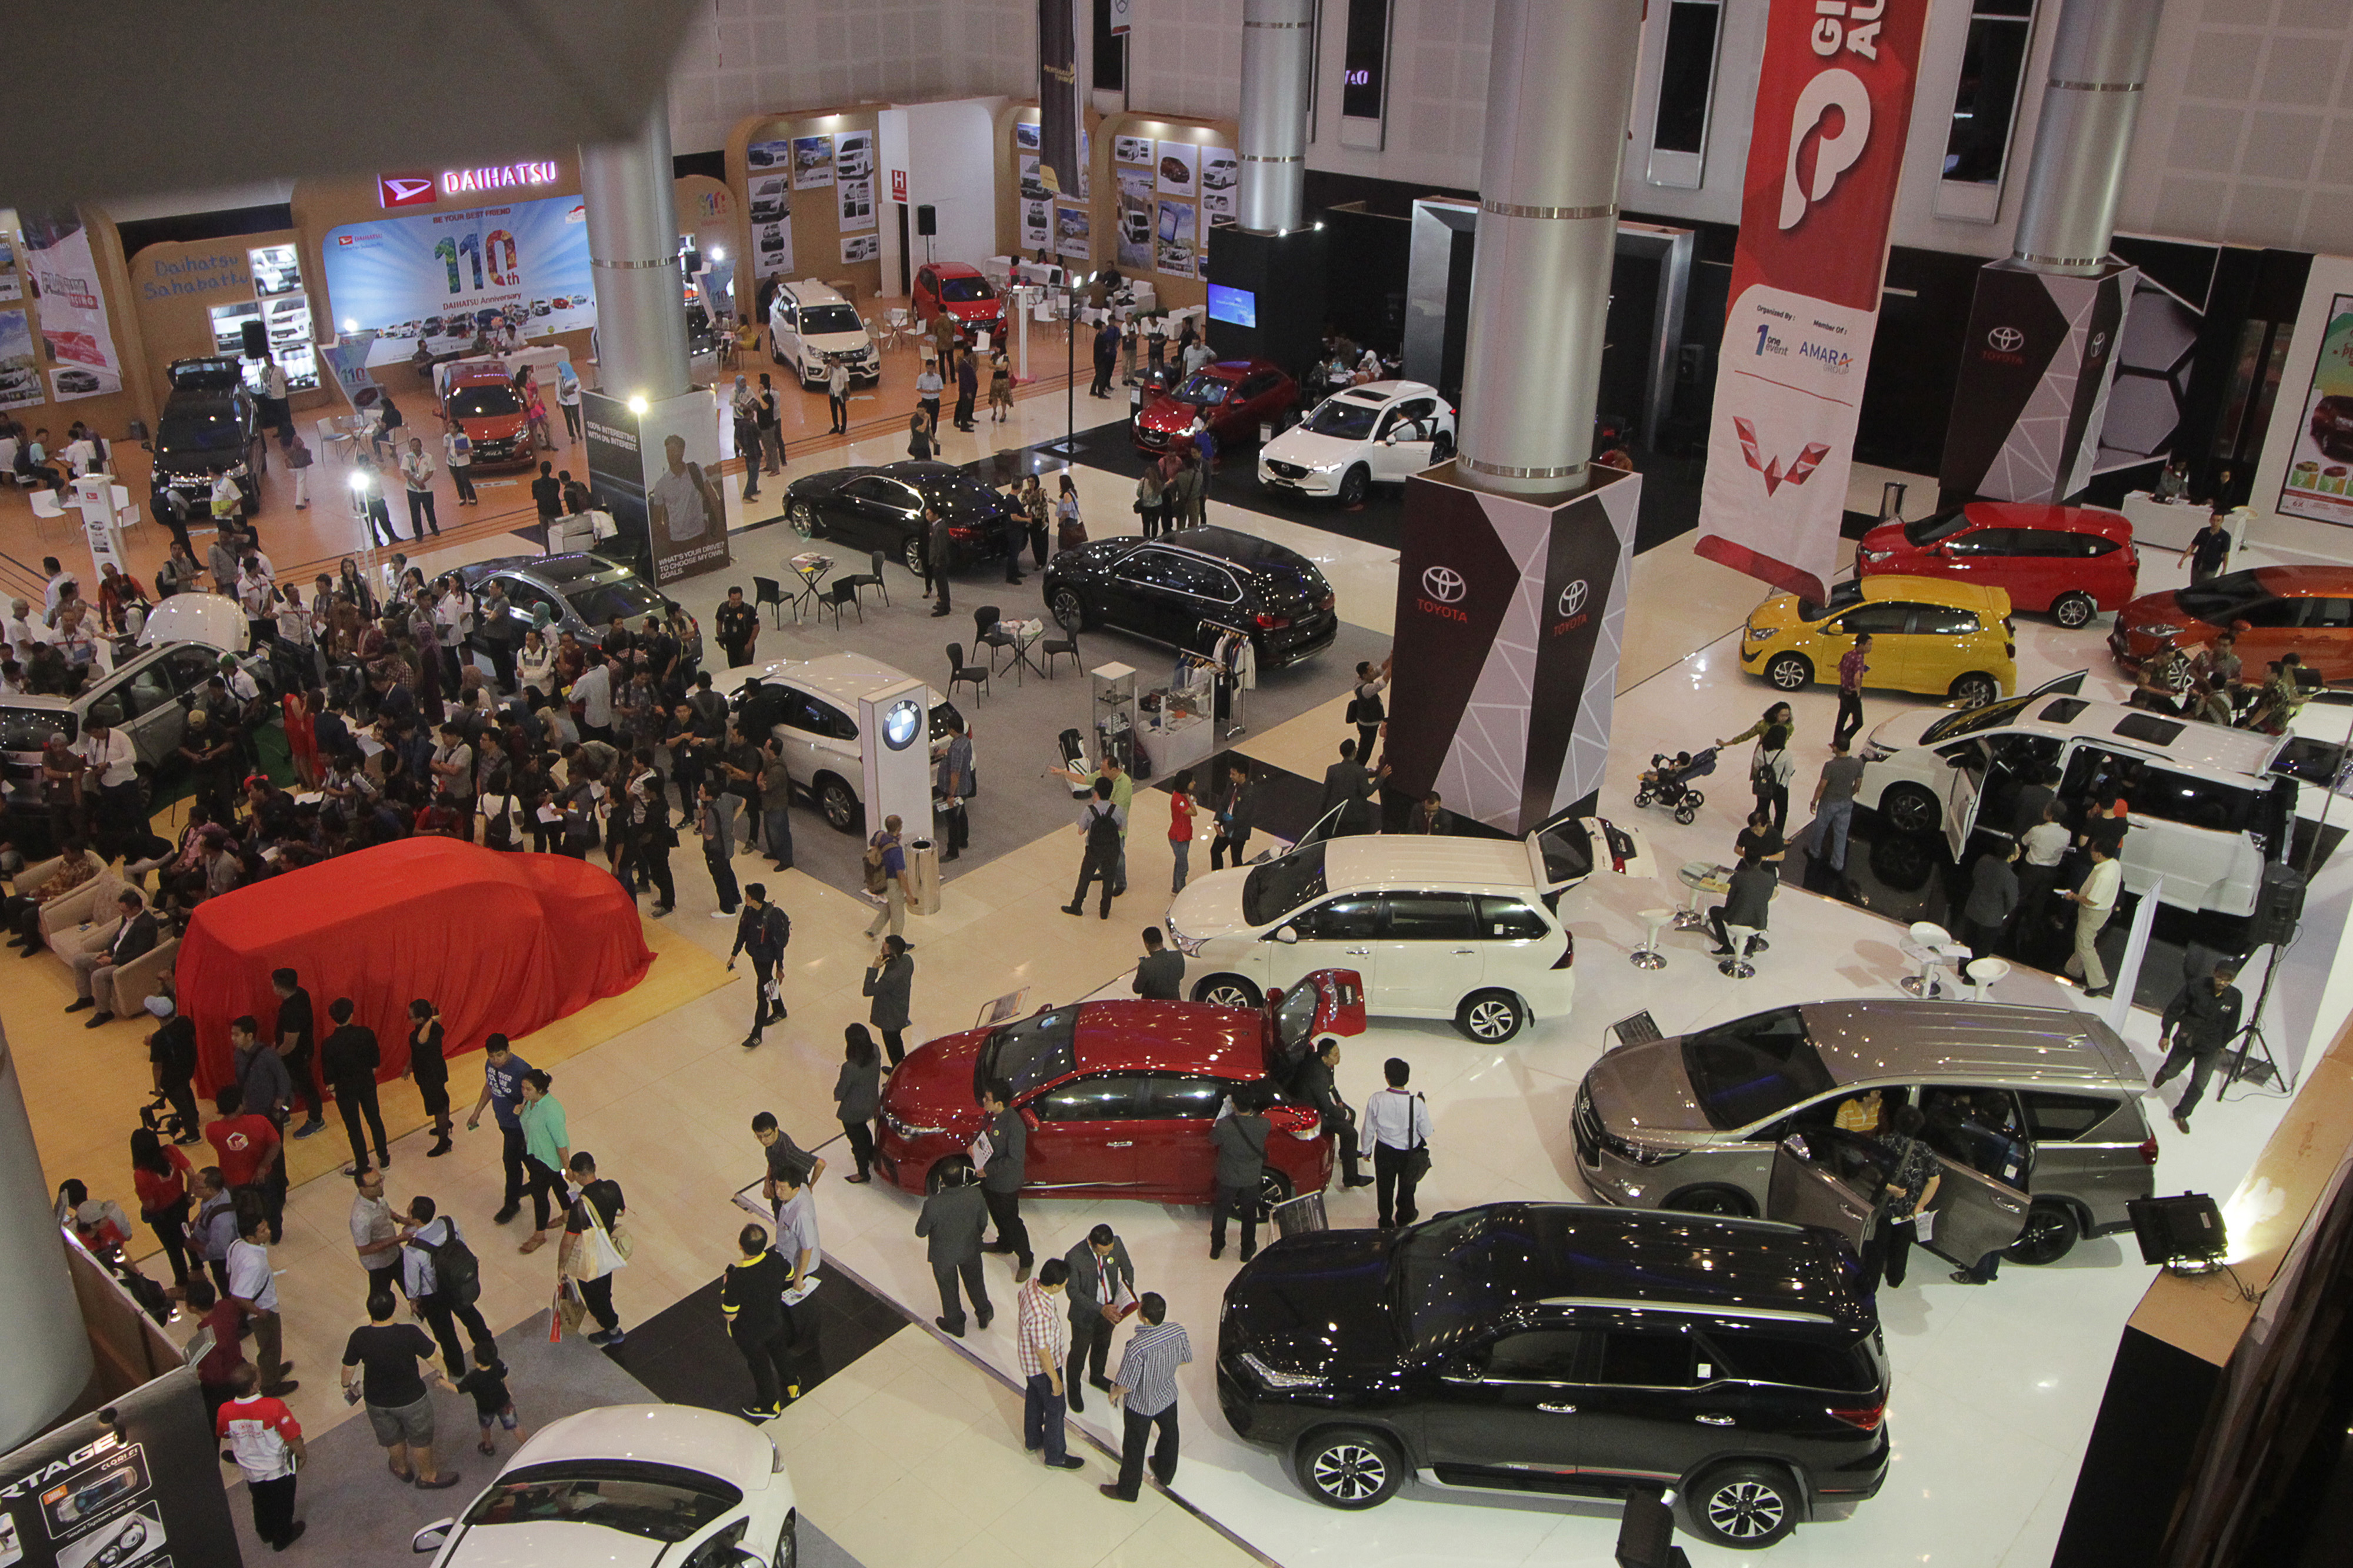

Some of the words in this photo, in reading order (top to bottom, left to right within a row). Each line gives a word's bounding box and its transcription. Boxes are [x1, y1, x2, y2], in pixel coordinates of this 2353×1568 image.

[443, 161, 558, 193] DAIHATSU
[894, 171, 904, 188] H
[444, 213, 464, 222] YOUR
[465, 211, 484, 220] BEST
[485, 208, 511, 217] FRIEND
[155, 255, 238, 276] Daihatsu
[434, 229, 518, 294] 110
[506, 272, 520, 285] th
[443, 298, 479, 311] DAIHATSU
[480, 292, 522, 305] Anniversary
[1757, 304, 1784, 318] Organized
[1784, 312, 1793, 321] By
[1812, 319, 1835, 332] Member
[1835, 326, 1844, 334] Of
[1765, 343, 1789, 356] event
[1767, 336, 1781, 346] one
[1799, 341, 1854, 368] AMARA
[1824, 362, 1849, 375] GROUP
[586, 421, 601, 432] 100%
[588, 430, 601, 441] WITH
[659, 553, 684, 566] WHAT'S
[684, 548, 702, 558] YOUR
[702, 541, 725, 553] DRIVE?
[669, 556, 697, 569] CHOOSE
[698, 553, 708, 562] MY
[708, 549, 724, 558] OWN
[660, 568, 684, 580] GOALS.
[1417, 598, 1468, 623] TOYOTA
[1553, 613, 1588, 636] TOYOTA
[48, 1490, 64, 1502] JBL
[66, 1525, 86, 1539] Sound
[87, 1513, 111, 1528] System
[111, 1504, 126, 1514] with
